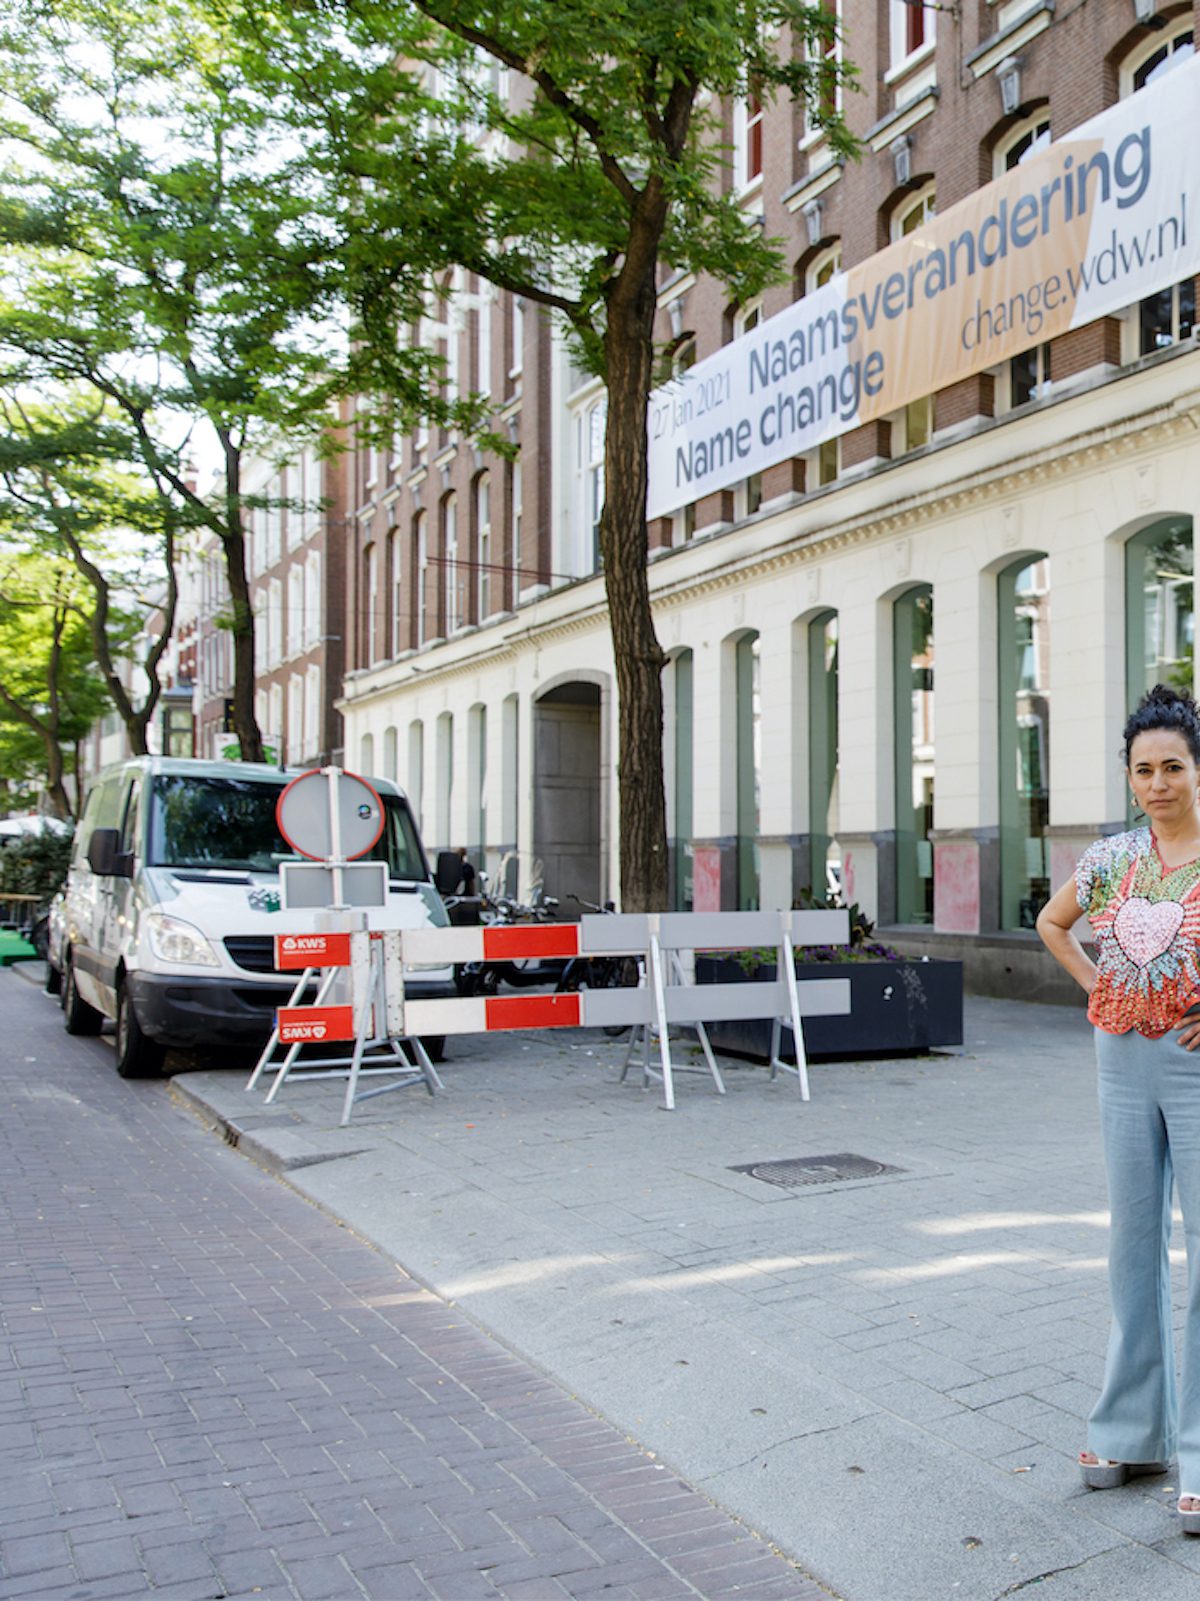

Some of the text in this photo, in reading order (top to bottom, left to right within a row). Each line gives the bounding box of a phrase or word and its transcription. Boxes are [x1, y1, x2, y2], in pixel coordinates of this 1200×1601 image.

[748, 125, 1153, 395] Naamsverandering
[961, 192, 1188, 351] change.wdw.nl
[653, 368, 731, 440] 27 Jan 2021
[676, 349, 885, 488] Name change
[298, 937, 327, 949] KWS
[282, 1026, 312, 1040] KWS
